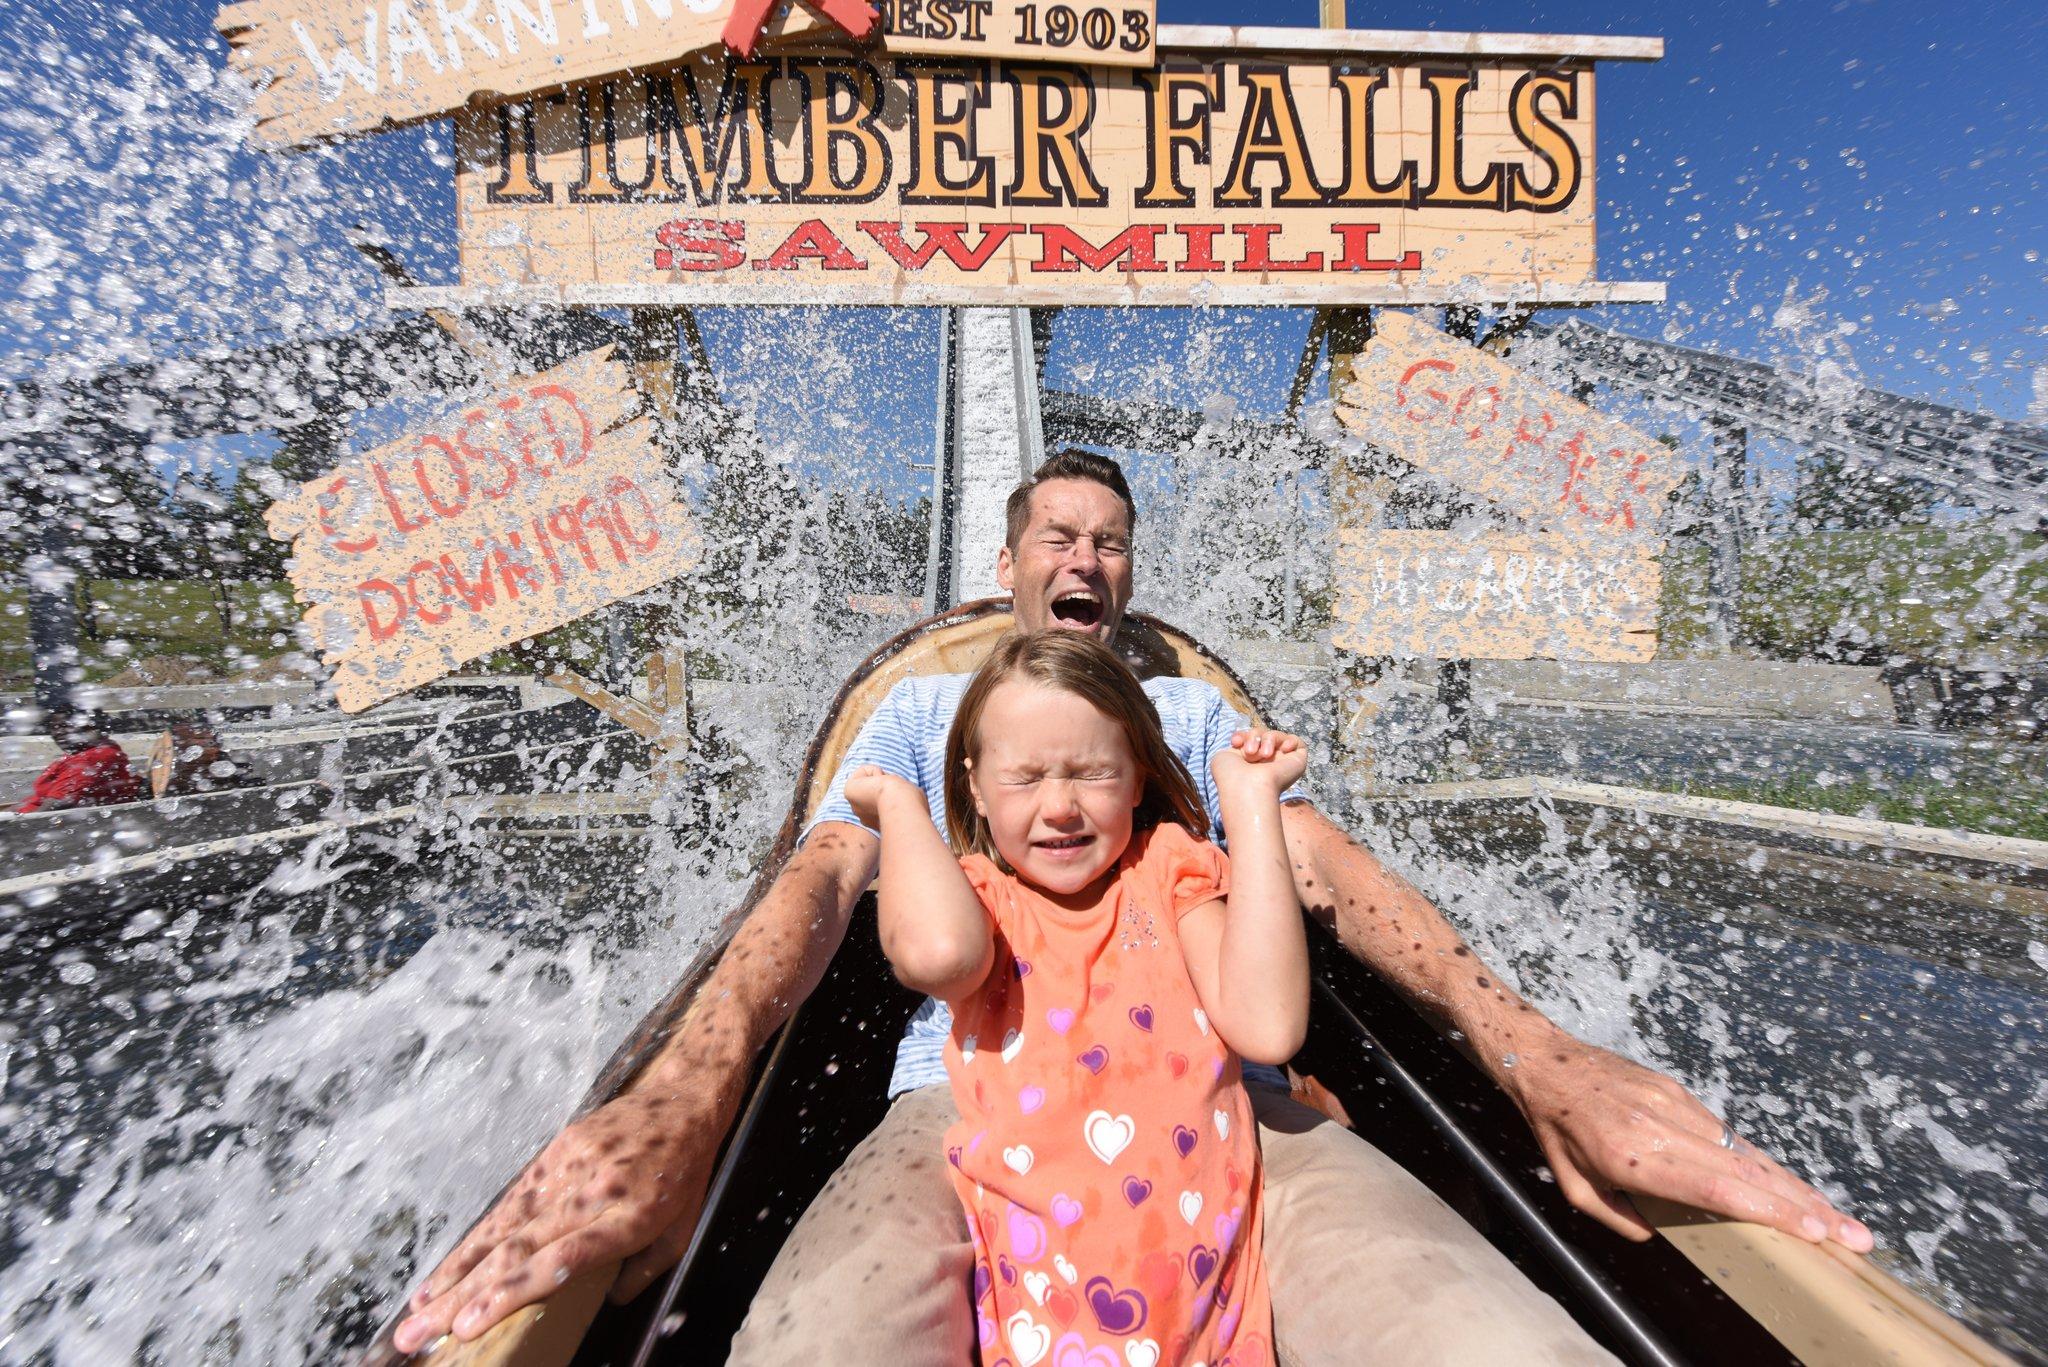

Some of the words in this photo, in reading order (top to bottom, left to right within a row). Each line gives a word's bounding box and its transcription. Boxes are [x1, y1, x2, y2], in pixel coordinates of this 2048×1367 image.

[885, 0, 992, 41] EST
[1014, 4, 1151, 52] 1903
[1134, 62, 1581, 213] FALLS
[654, 219, 1422, 272] SAWMILL
[1397, 359, 1500, 440] GO
[357, 531, 543, 642] DOWN
[532, 475, 661, 587] 1990
